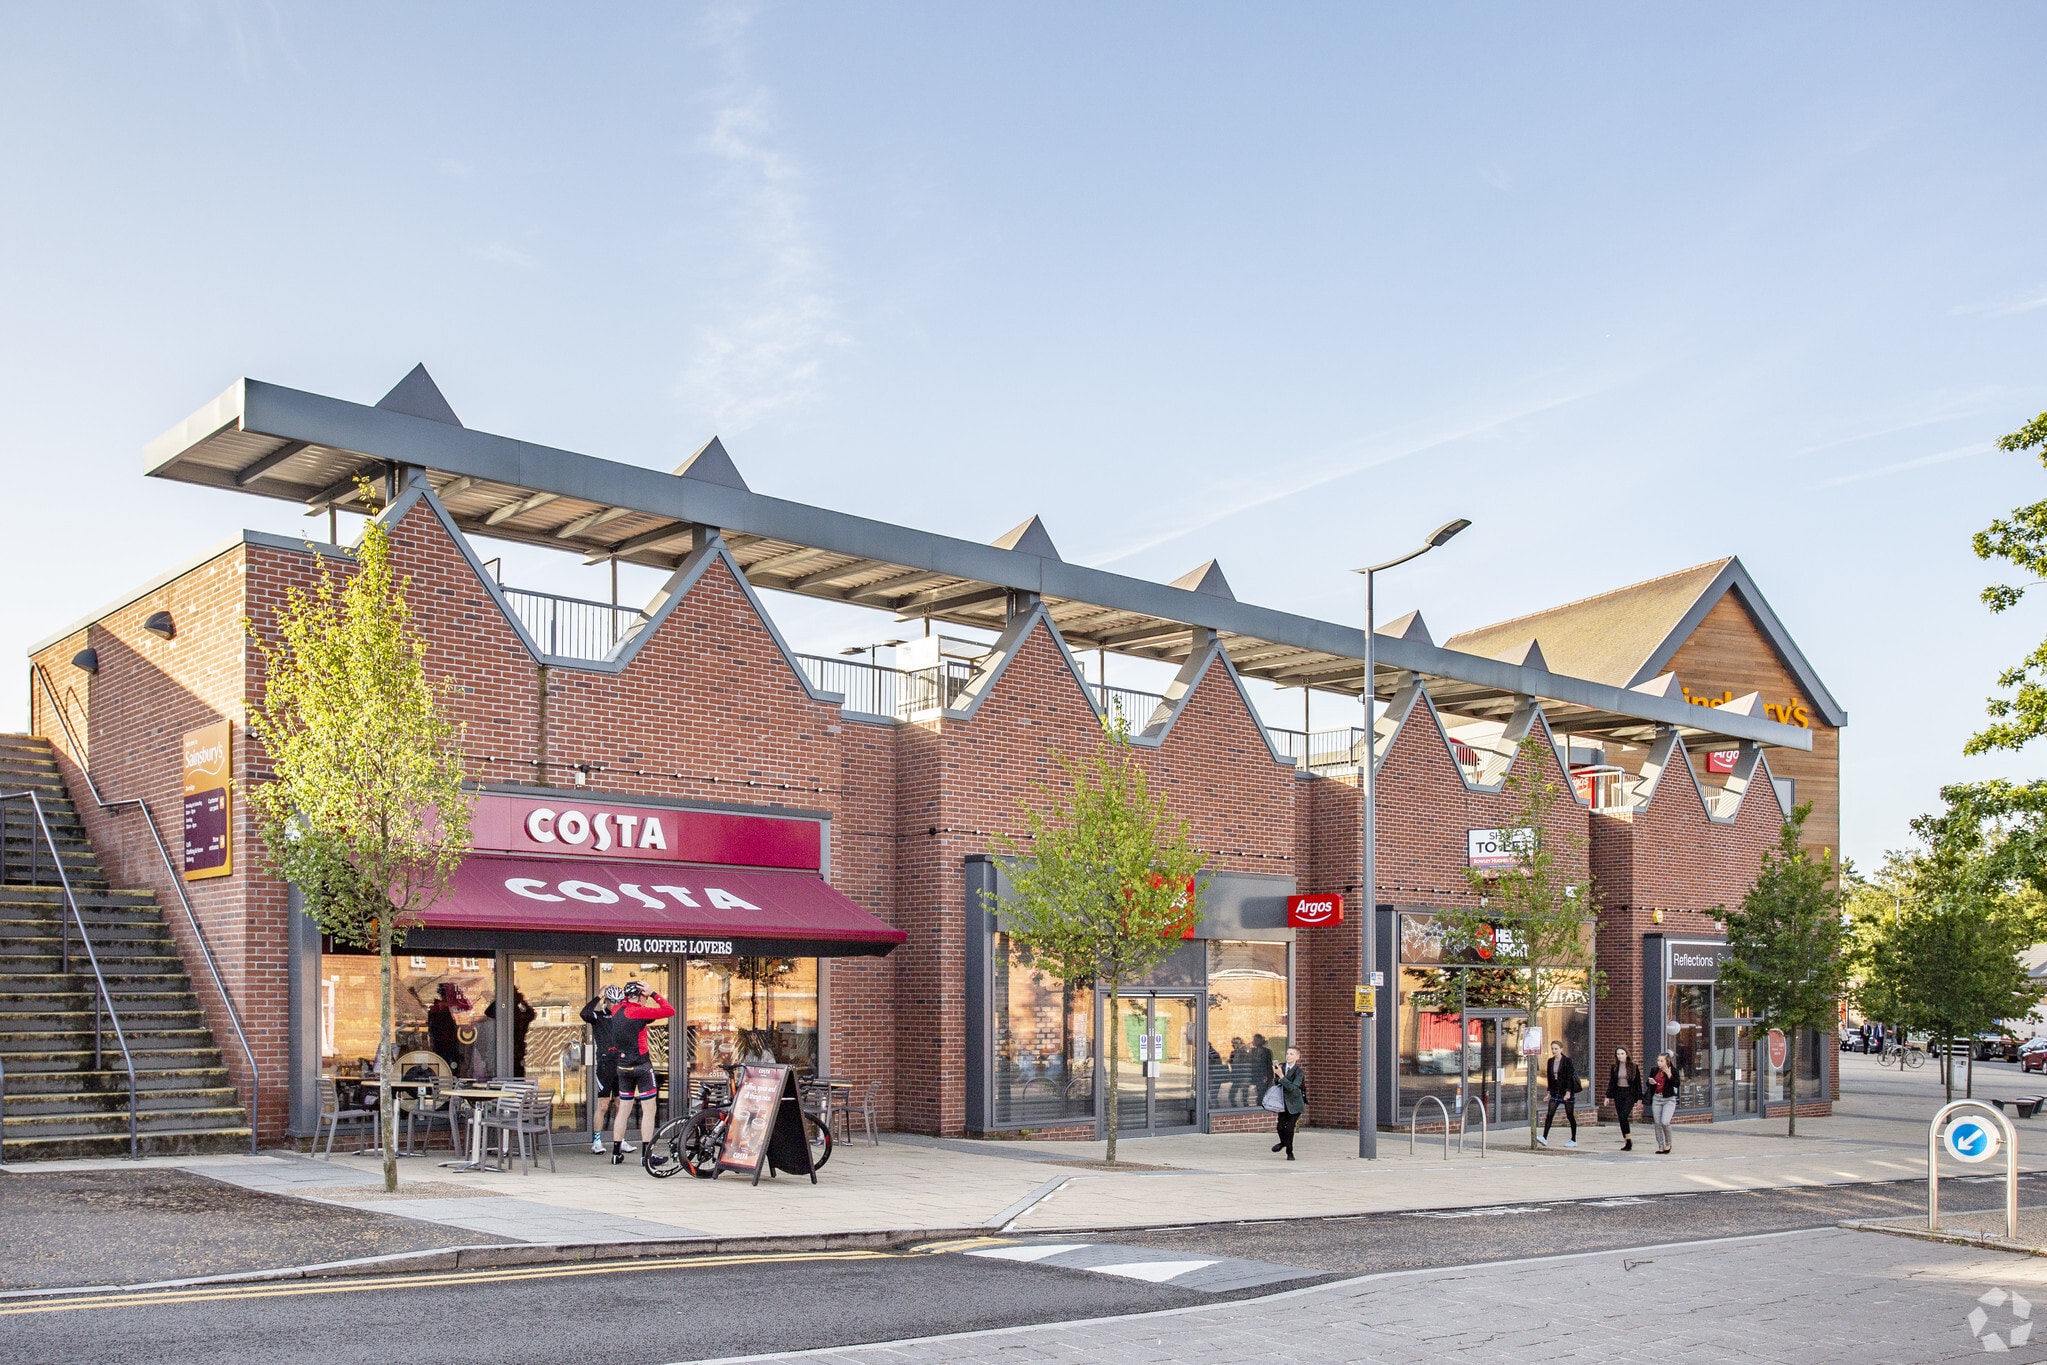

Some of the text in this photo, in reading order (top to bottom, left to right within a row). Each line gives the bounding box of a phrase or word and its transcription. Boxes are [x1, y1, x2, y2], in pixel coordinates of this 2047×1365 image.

[185, 742, 223, 768] Sainsbury's
[1713, 750, 1740, 763] Argo
[526, 808, 667, 851] COSTA
[1475, 841, 1497, 853] TO
[504, 877, 763, 911] COSTA
[1295, 899, 1333, 917] Argos
[616, 938, 733, 955] FOR COFFEE LOVERS
[1673, 952, 1714, 967] Reflections
[732, 1151, 749, 1160] COSTA
